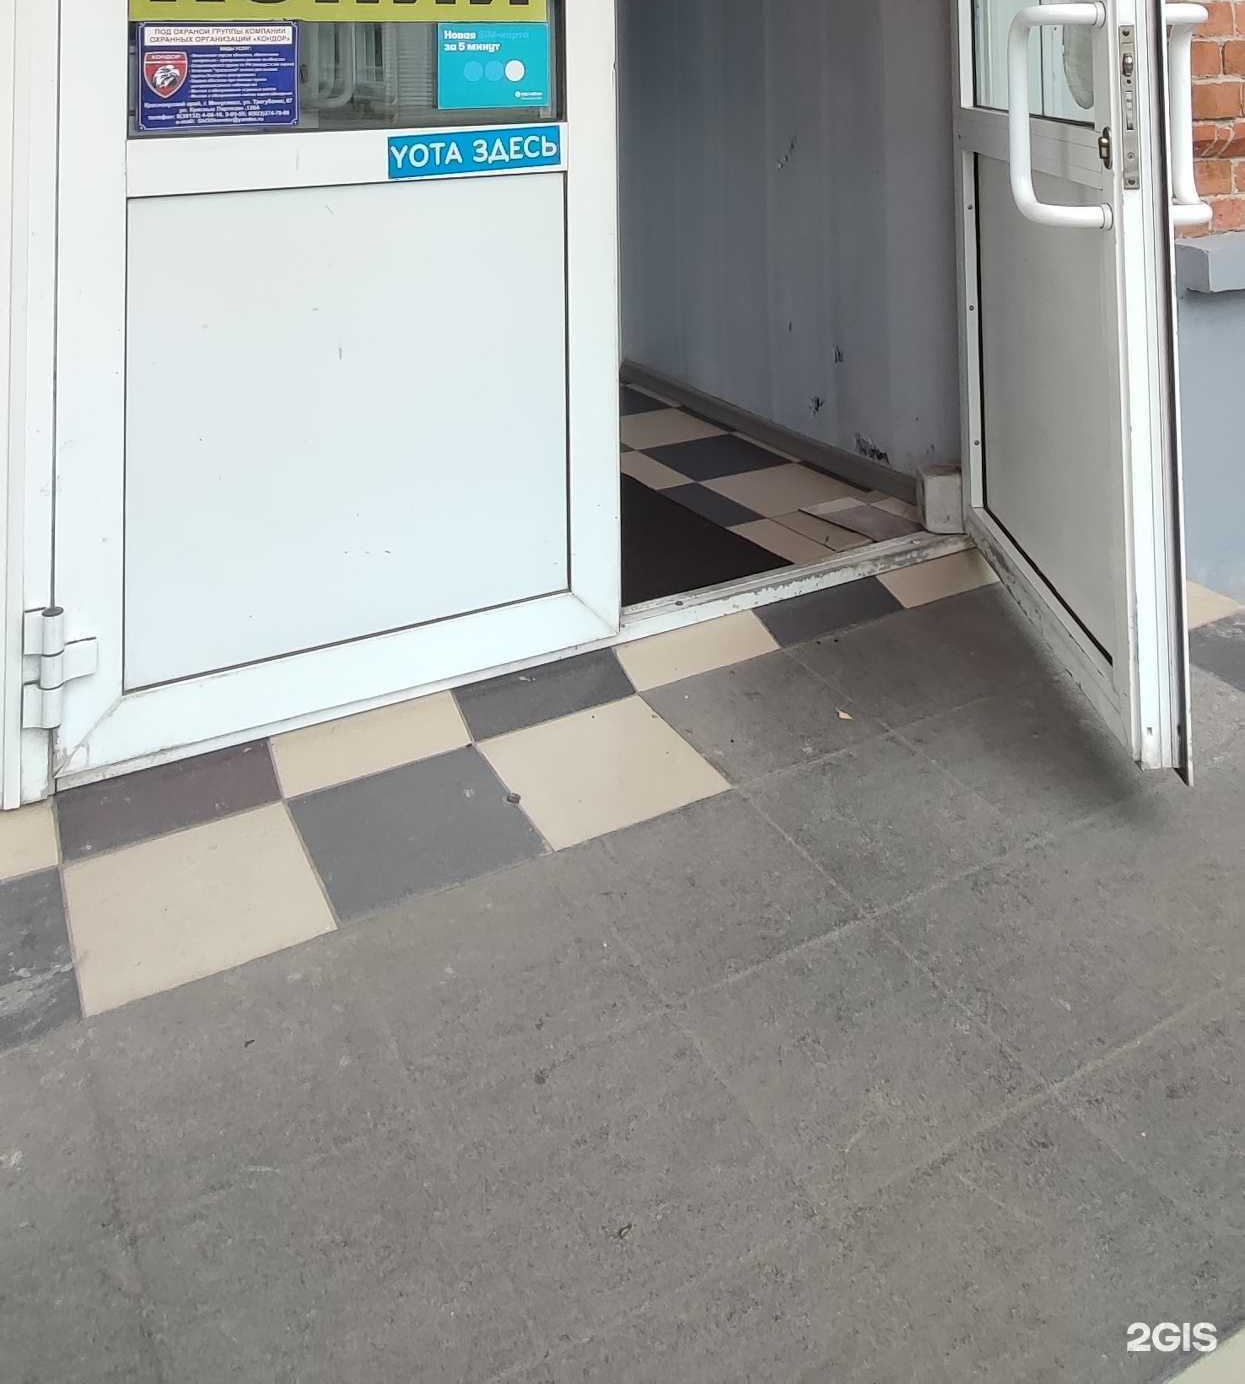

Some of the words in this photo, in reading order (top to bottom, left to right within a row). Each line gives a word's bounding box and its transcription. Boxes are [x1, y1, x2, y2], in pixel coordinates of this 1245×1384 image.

[444, 30, 476, 40] Новая
[458, 42, 466, 51] 5
[467, 44, 500, 53] минут
[391, 140, 463, 169] YOTA
[472, 135, 558, 165] ЗДЕСЬ
